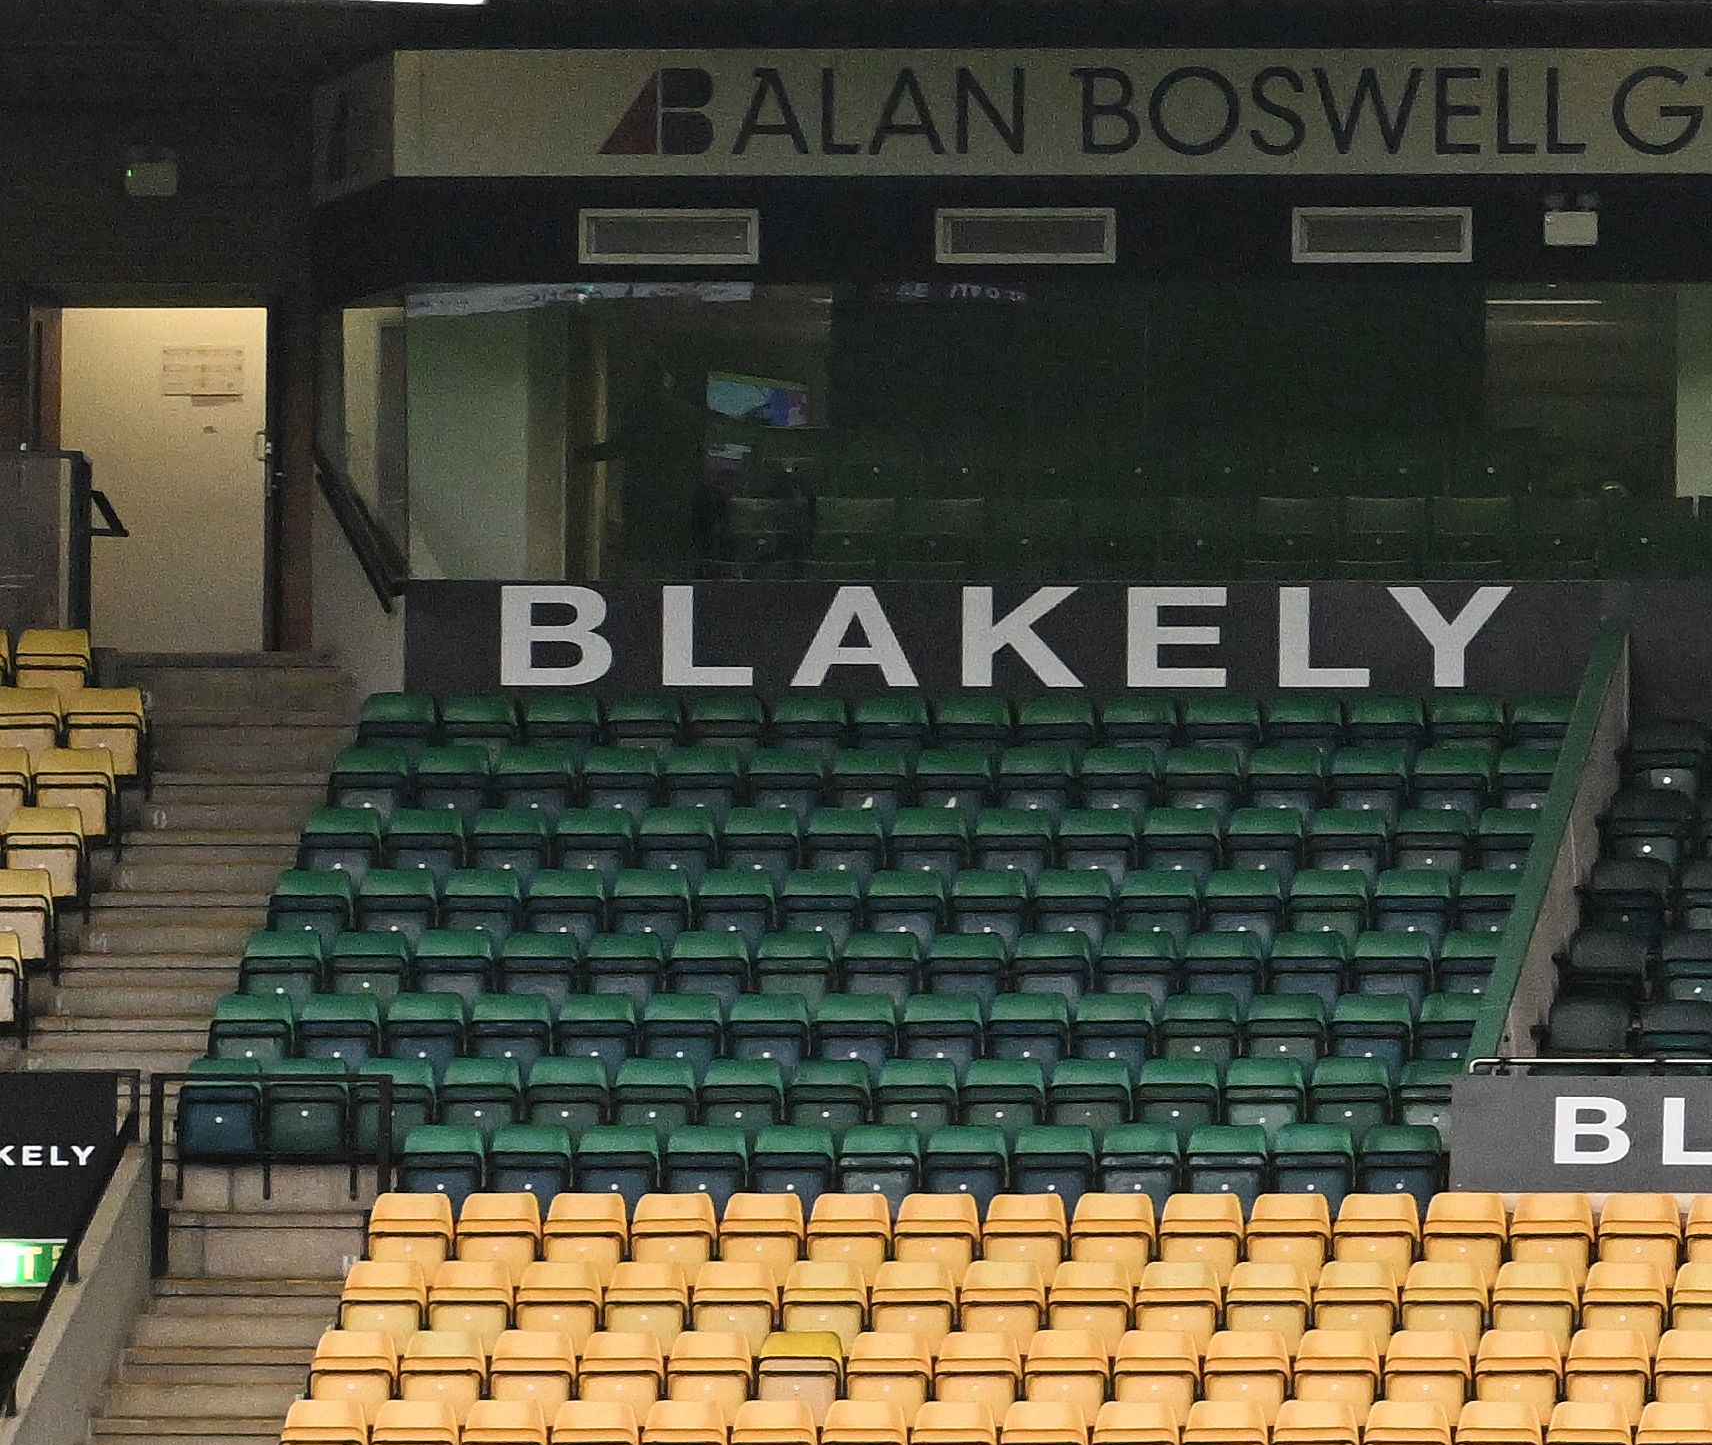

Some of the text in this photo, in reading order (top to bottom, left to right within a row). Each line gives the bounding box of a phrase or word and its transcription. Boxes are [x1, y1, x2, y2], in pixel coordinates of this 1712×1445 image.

[731, 63, 1026, 156] ALAN
[1067, 65, 1587, 157] BOSWELL
[500, 585, 1513, 688] BLAKELY
